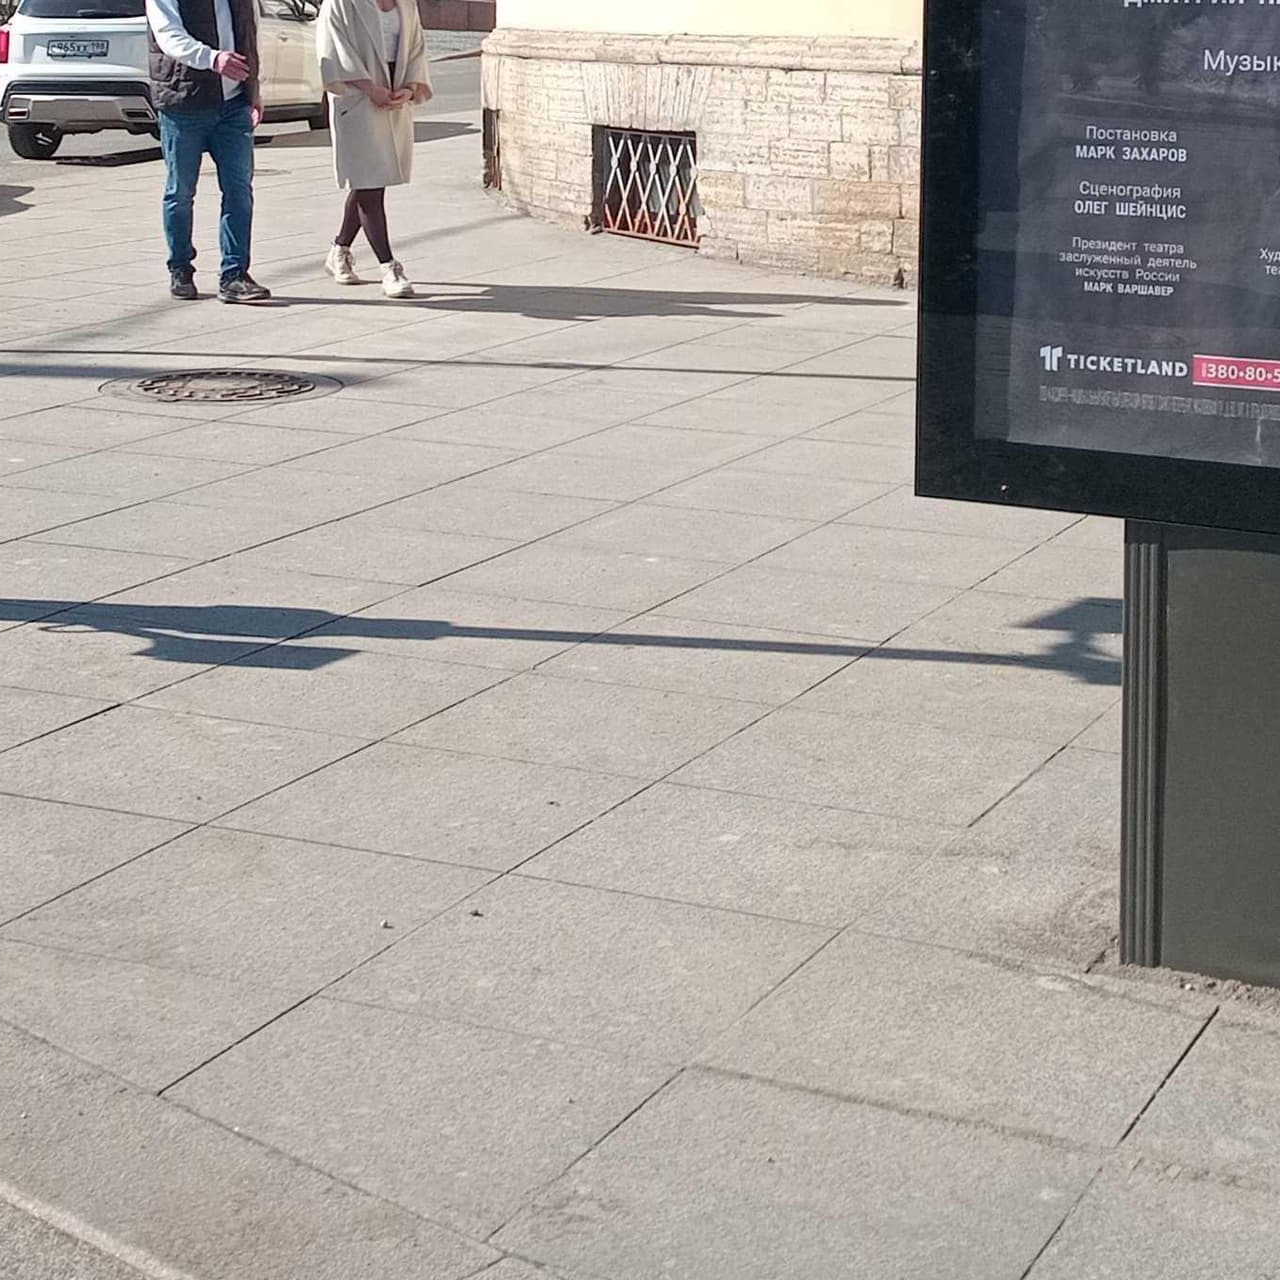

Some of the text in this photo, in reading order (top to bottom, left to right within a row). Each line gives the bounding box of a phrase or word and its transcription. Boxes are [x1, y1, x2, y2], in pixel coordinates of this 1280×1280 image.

[1085, 125, 1177, 142] Постановка
[1075, 145, 1187, 162] МАРК ЗАХАРОВ
[1080, 181, 1181, 200] Сценография
[1074, 200, 1187, 220] ОЛЕГ ШЕЙНЦИС
[1072, 236, 1184, 255] Президент театра
[1059, 252, 1197, 269] заслуженный деятель
[1075, 267, 1180, 282] искусств России
[1083, 281, 1174, 296] МАРК ВАРШАВЕР
[1067, 353, 1188, 377] TICKETLAND
